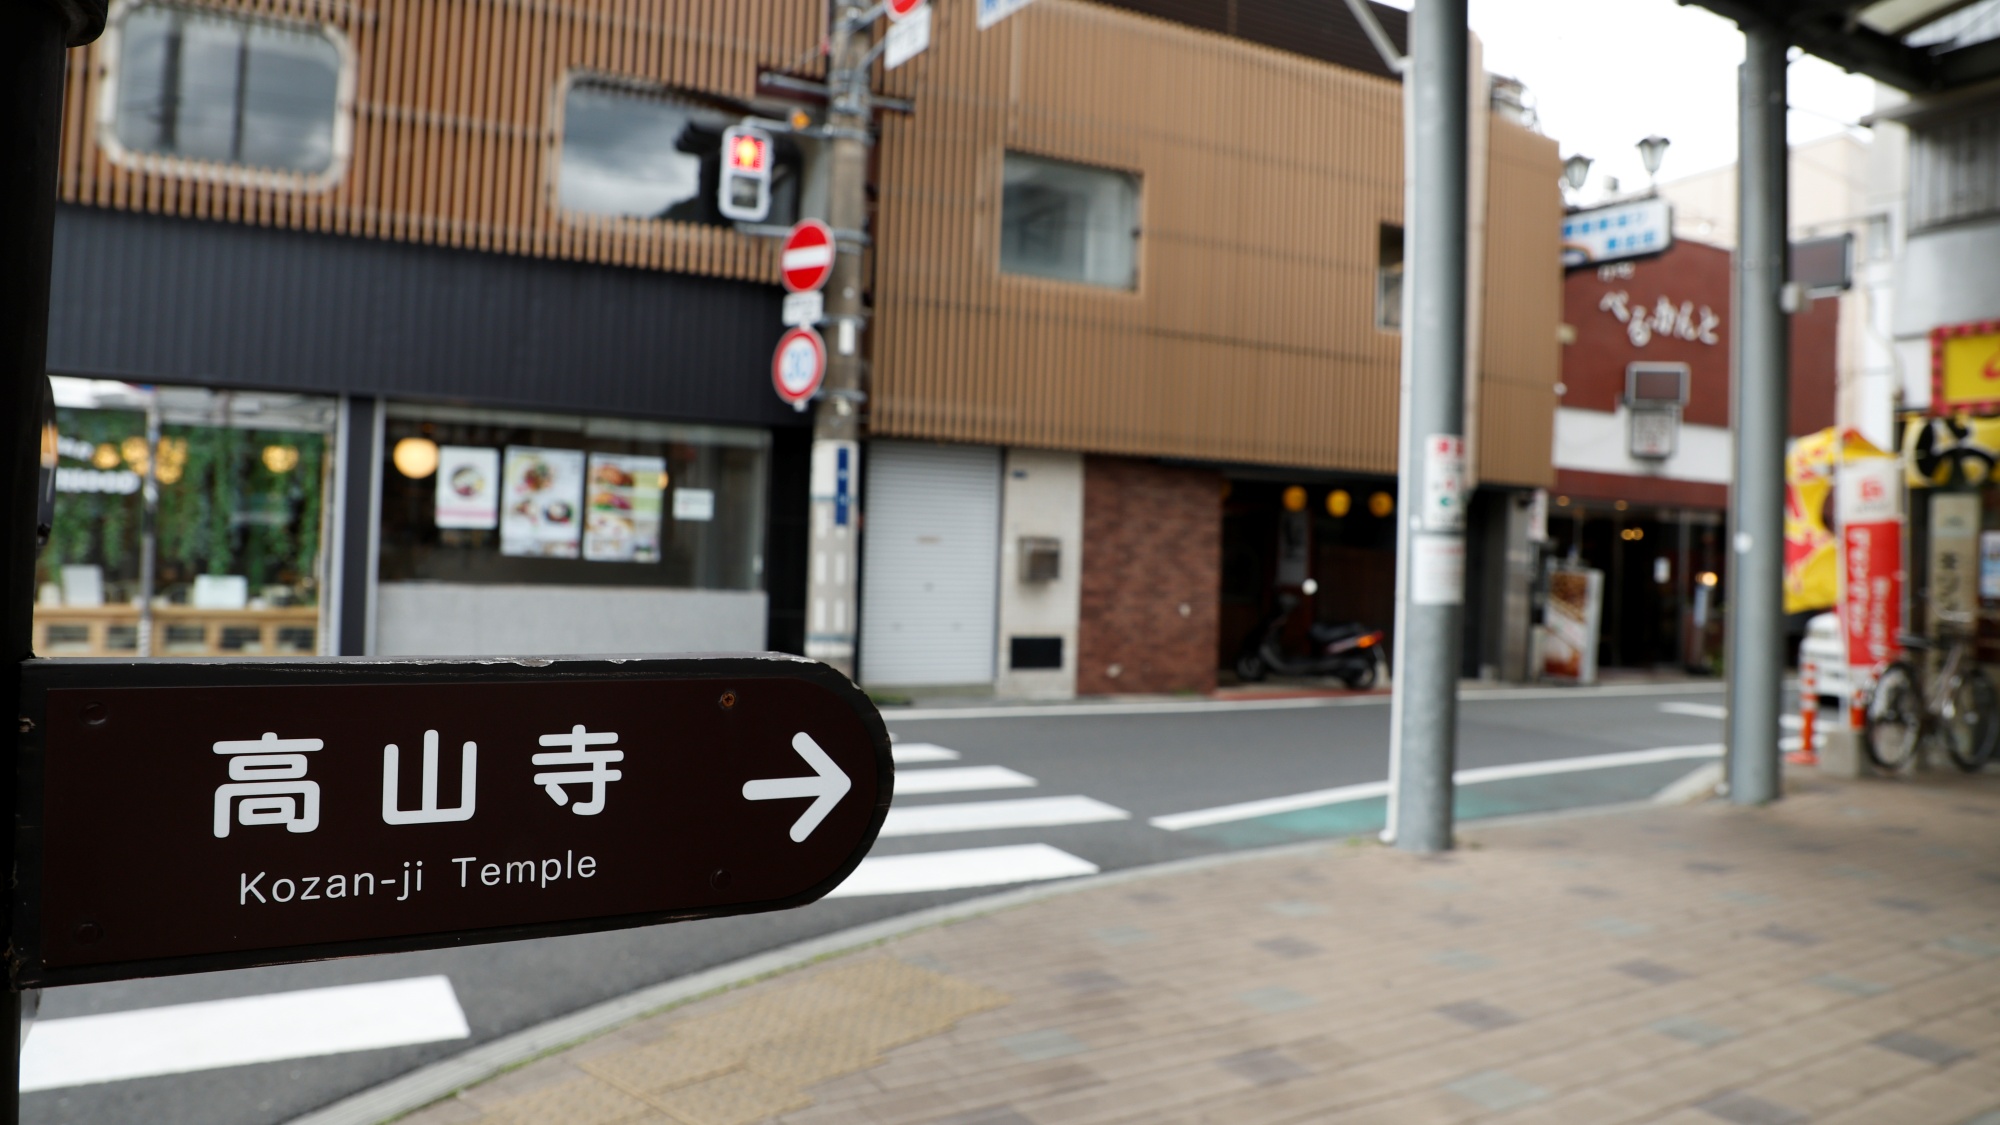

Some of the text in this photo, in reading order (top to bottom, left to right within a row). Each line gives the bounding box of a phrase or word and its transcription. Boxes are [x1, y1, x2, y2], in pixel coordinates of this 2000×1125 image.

[212, 724, 625, 839] 高山寺
[240, 849, 597, 906] Kozan-ji Temple
